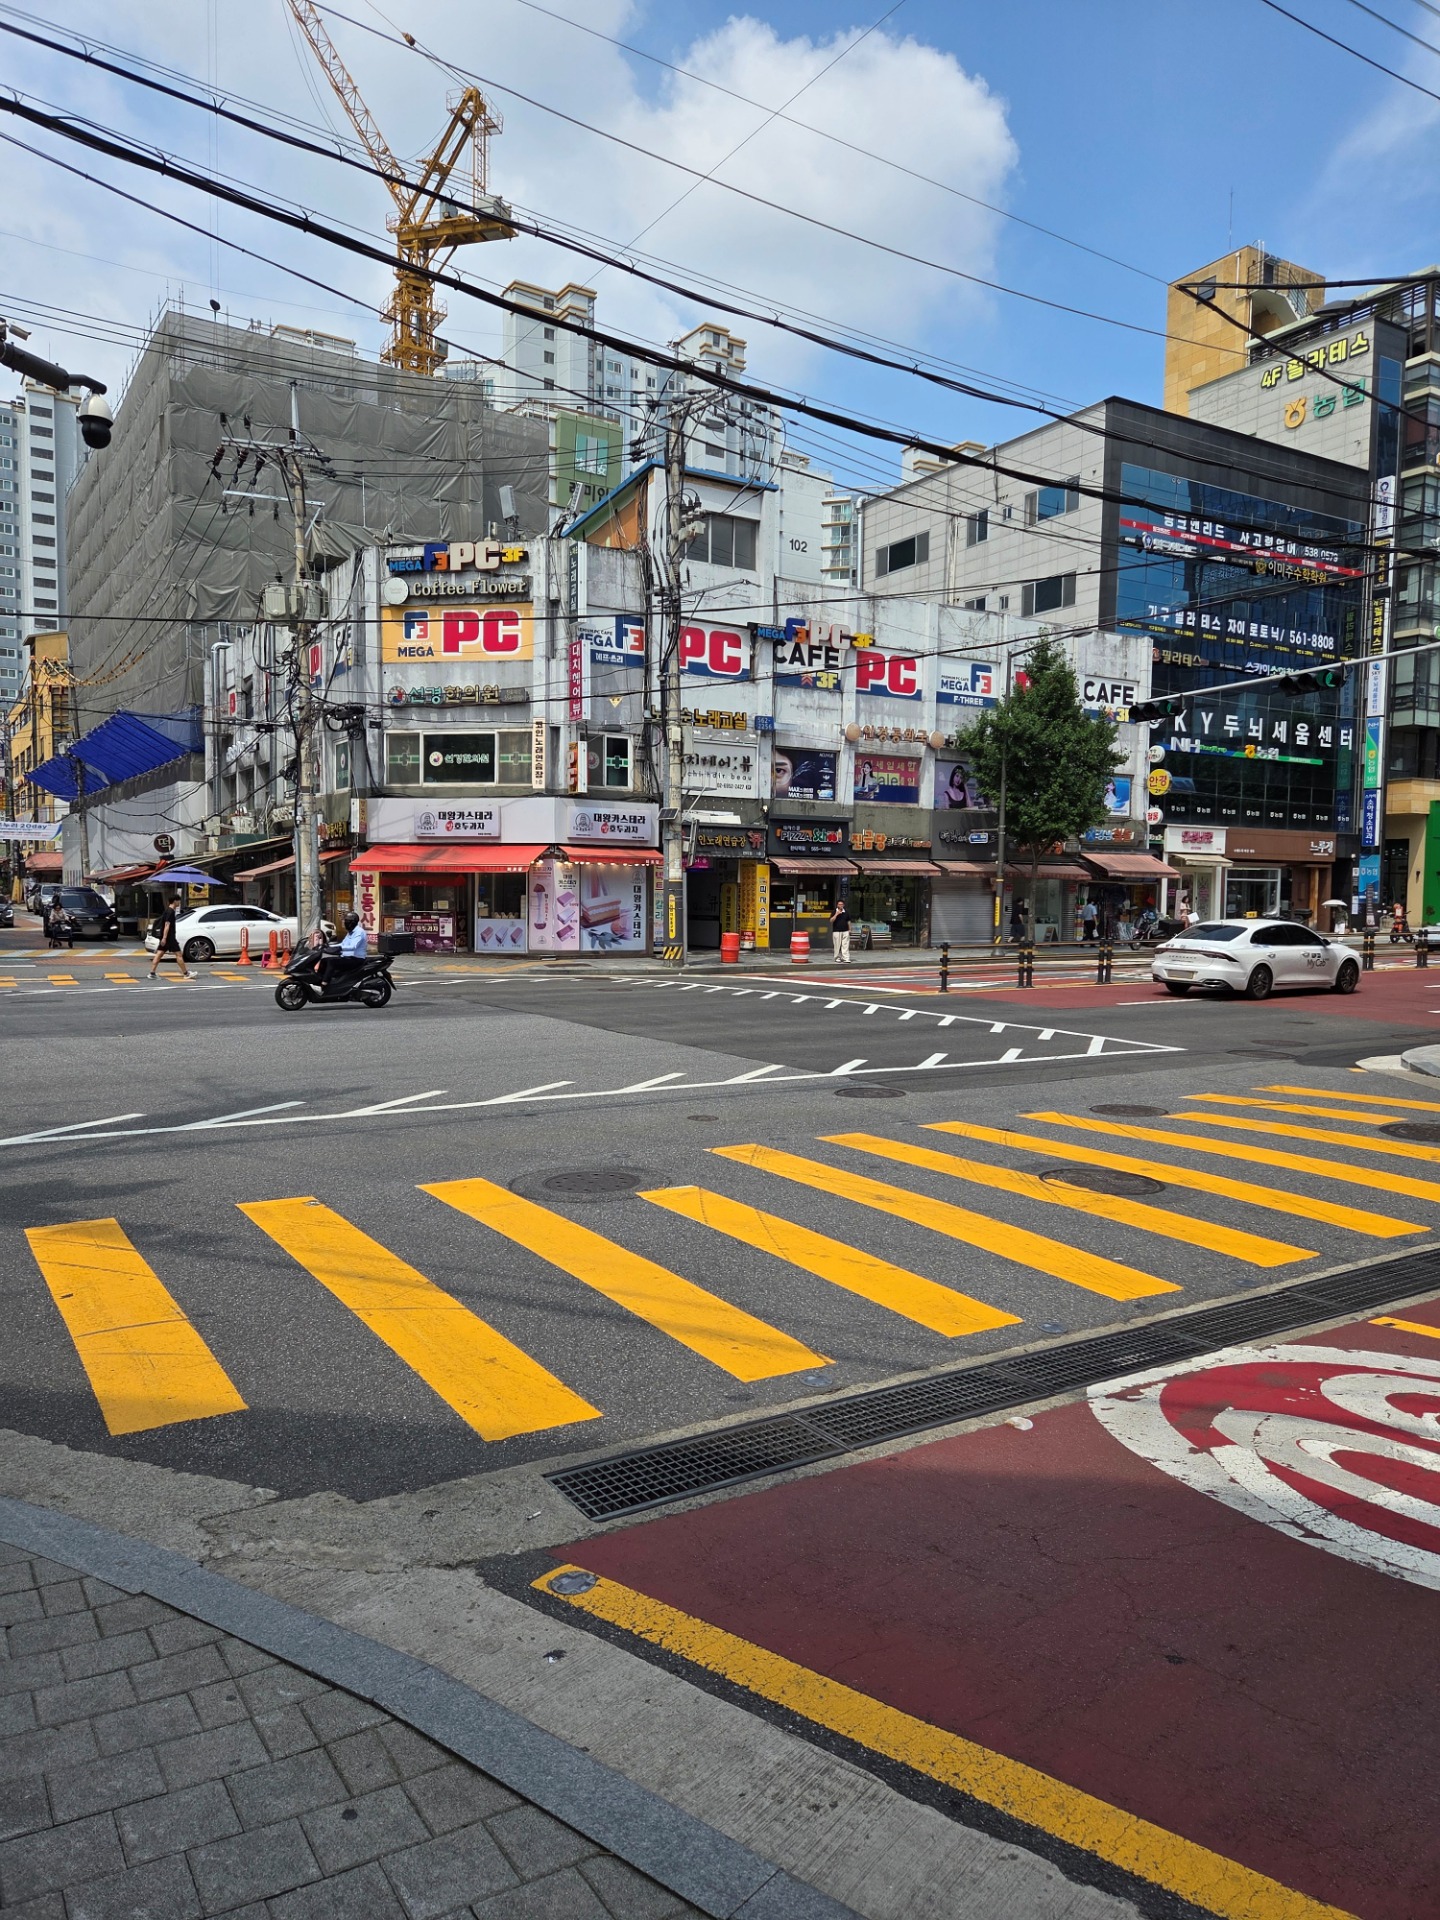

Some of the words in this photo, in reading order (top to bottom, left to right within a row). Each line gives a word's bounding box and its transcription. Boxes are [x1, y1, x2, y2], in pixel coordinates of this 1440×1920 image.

[1262, 367, 1282, 389] 4F
[1287, 332, 1369, 381] 필라테스
[1313, 377, 1366, 418] 농협
[789, 538, 808, 553] 102
[389, 560, 422, 571] MEGA
[424, 543, 448, 571] F3
[450, 541, 500, 571] PC
[501, 547, 525, 563] 3F
[413, 582, 465, 596] Coffee
[471, 579, 528, 595] Flower
[403, 611, 429, 640] F3
[442, 611, 520, 654] PC
[615, 615, 645, 652] F3
[757, 627, 786, 640] MEGA
[786, 617, 807, 643] F3
[810, 619, 851, 650] PC
[852, 632, 874, 648] 3F
[398, 646, 434, 657] MEGA
[680, 625, 742, 674] PC
[773, 640, 839, 669] CAFE
[1162, 650, 1202, 667] 필라테스
[856, 650, 917, 695] PC
[1244, 661, 1271, 676] 스카이
[816, 672, 838, 688] 3F
[941, 679, 970, 692] MEGA
[970, 663, 992, 695] F3
[409, 685, 499, 705] 선경한의원
[1084, 680, 1135, 706] CAFE
[694, 708, 748, 731] 노래교실
[863, 726, 929, 746] 안경공화국
[1166, 737, 1200, 754] NH
[1257, 746, 1279, 760] 농협
[1149, 775, 1168, 788] 안경
[20, 822, 48, 830] 20day
[438, 811, 493, 821] 대왕카스테라
[593, 813, 647, 825] 대왕카스테라
[454, 822, 485, 831] 호두과자
[609, 825, 639, 834] 호두과자
[781, 831, 813, 842] PIZZA
[158, 836, 171, 851] 떡
[852, 830, 887, 851] 진금당
[360, 873, 376, 932] 부동산
[633, 884, 642, 939] 대왕카스테라
[1307, 958, 1327, 970] MyCab
